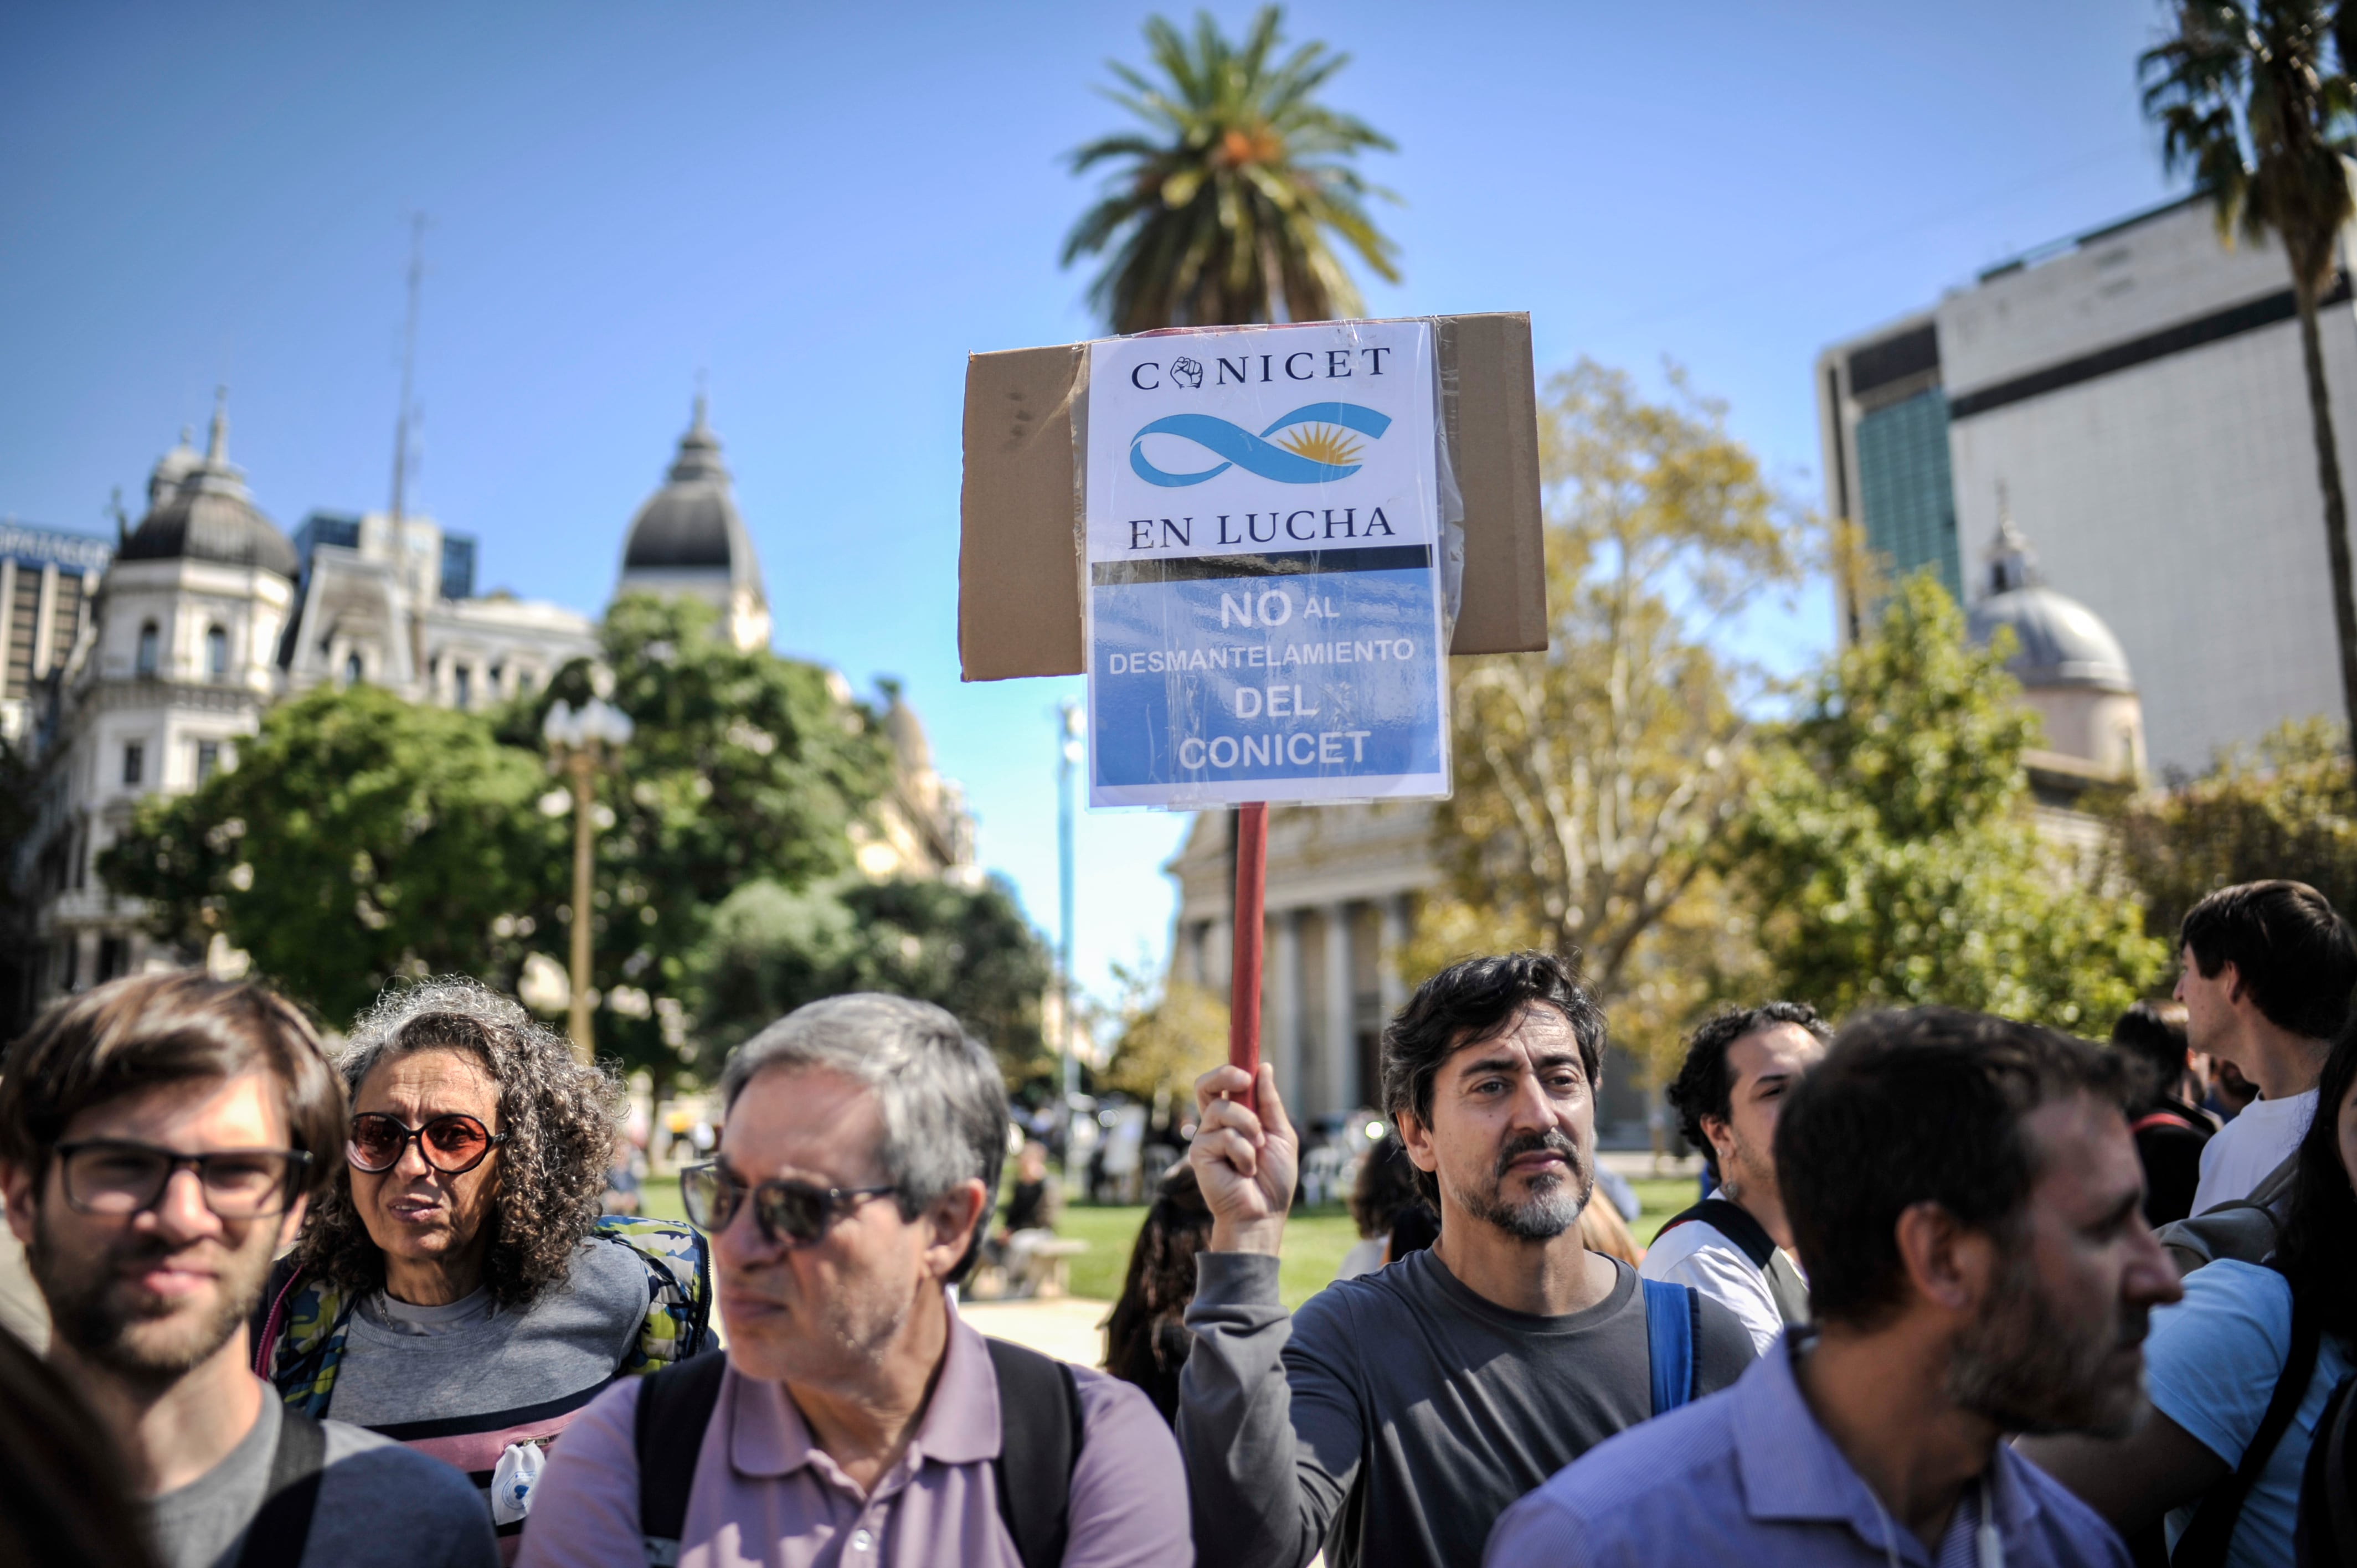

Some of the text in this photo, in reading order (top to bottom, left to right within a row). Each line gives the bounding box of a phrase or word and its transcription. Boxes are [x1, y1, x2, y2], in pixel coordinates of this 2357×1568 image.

[1128, 507, 1396, 550] EN LUCHA
[1221, 589, 1340, 629] NO AL
[1109, 638, 1415, 675] DESMANTELAMIENTO
[1235, 684, 1320, 719] DEL
[1179, 730, 1371, 770] CONICET
